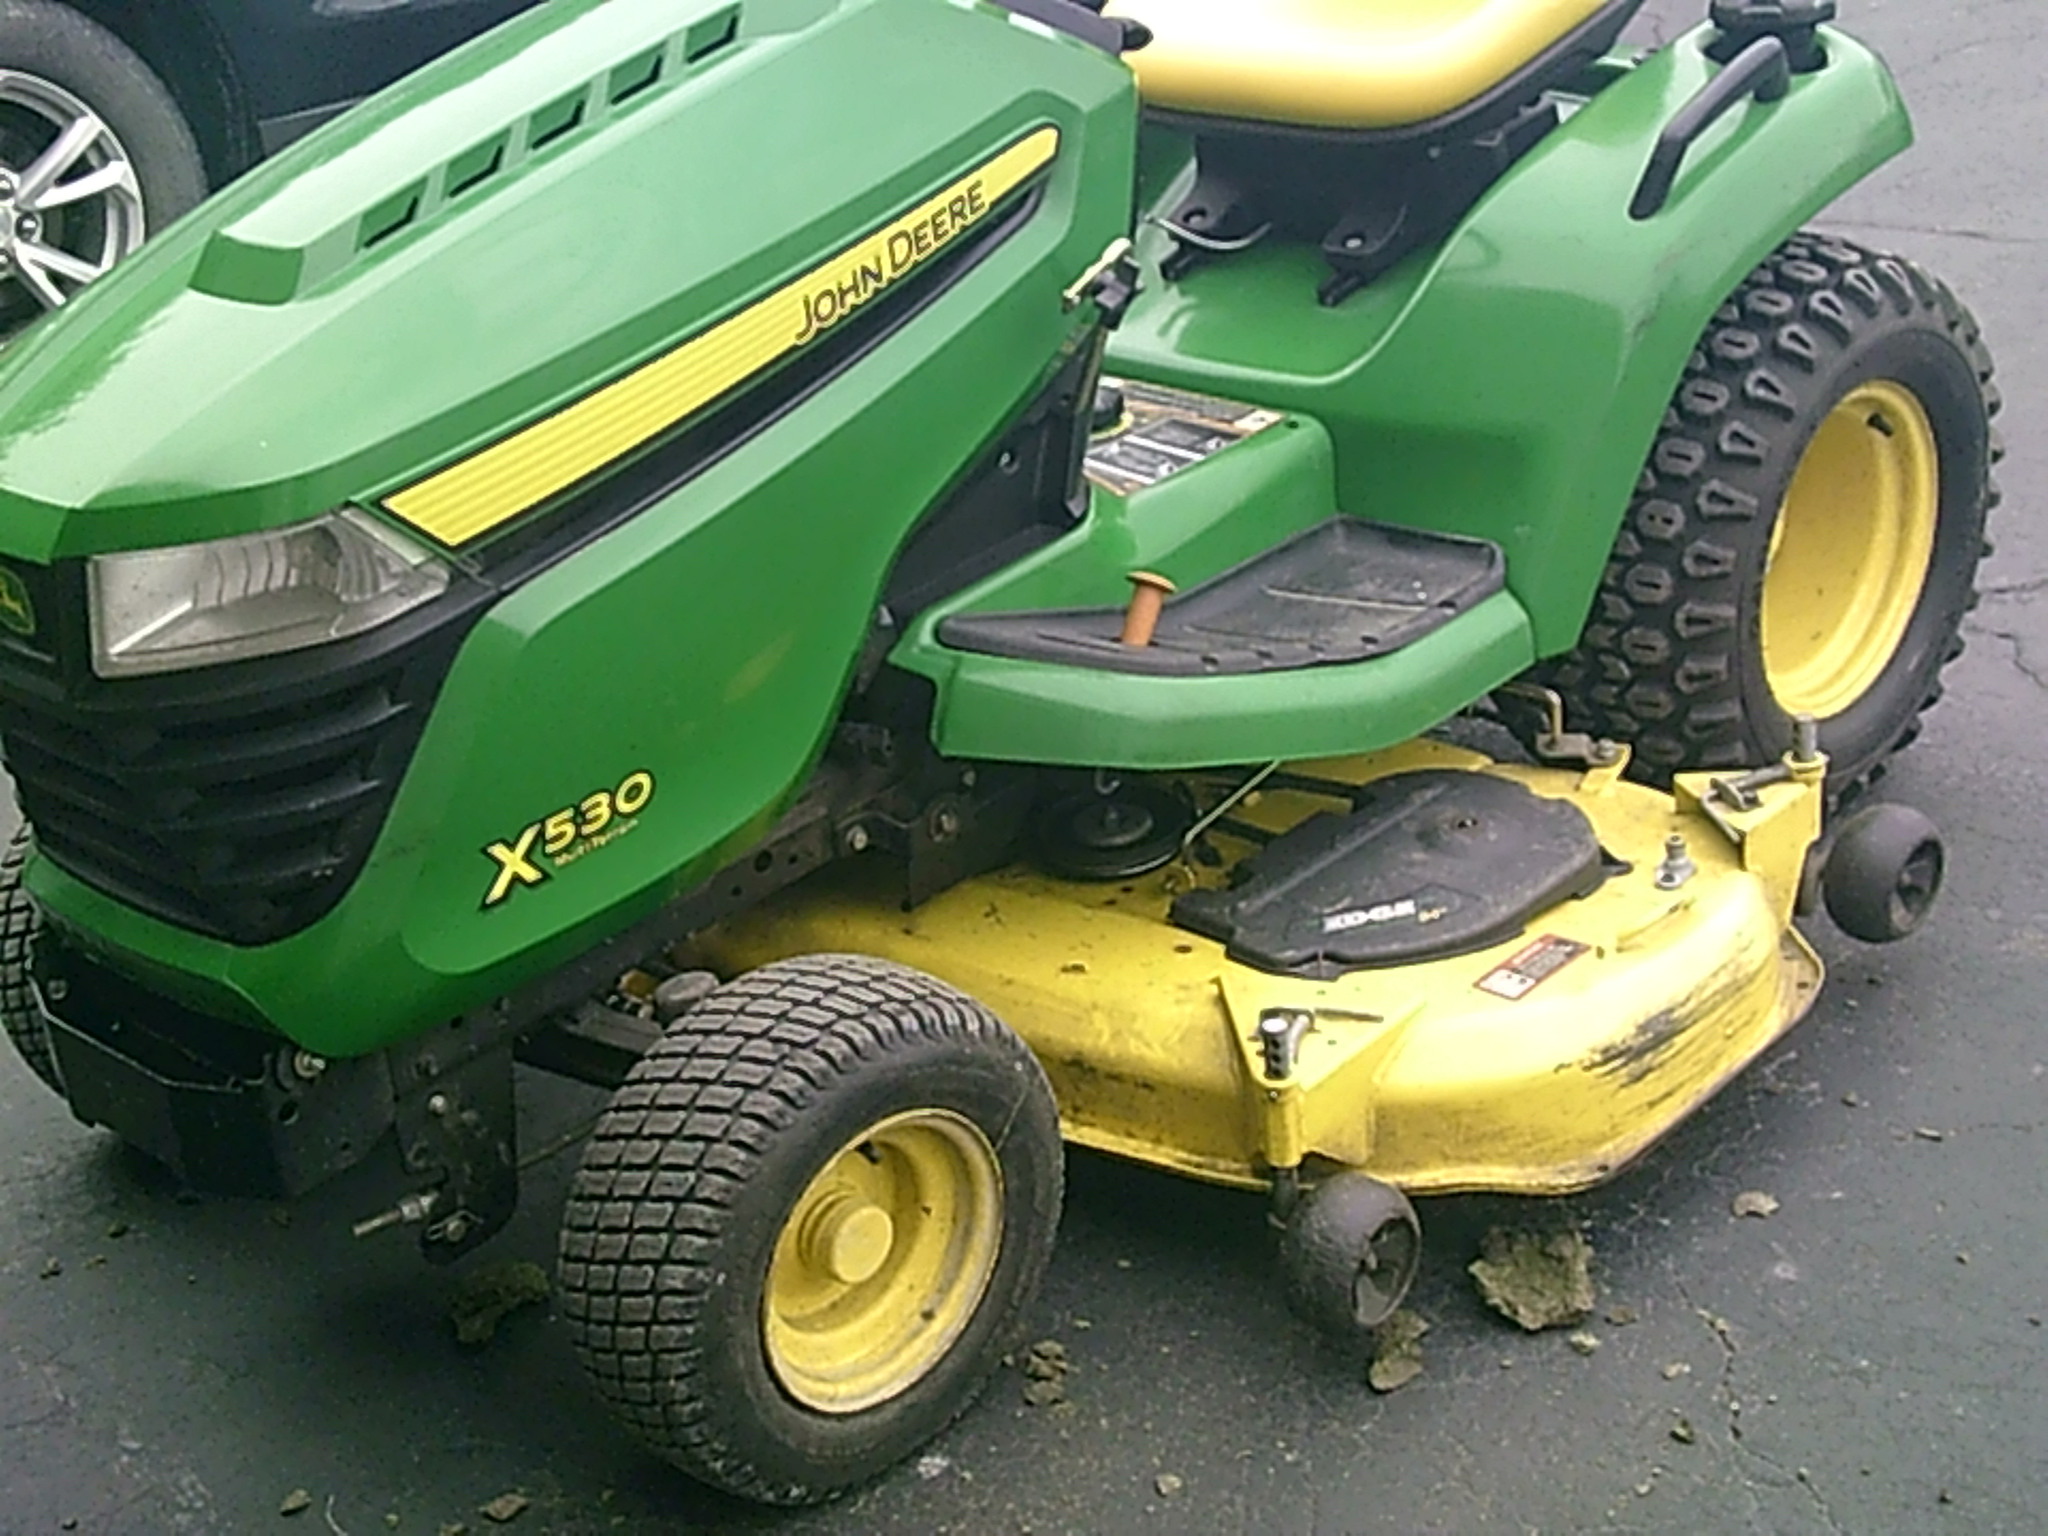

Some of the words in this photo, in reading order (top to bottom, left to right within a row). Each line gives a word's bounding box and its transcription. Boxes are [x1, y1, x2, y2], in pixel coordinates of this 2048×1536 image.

[795, 254, 883, 341] JOHN
[887, 179, 986, 274] DEERE
[482, 770, 655, 908] X530
